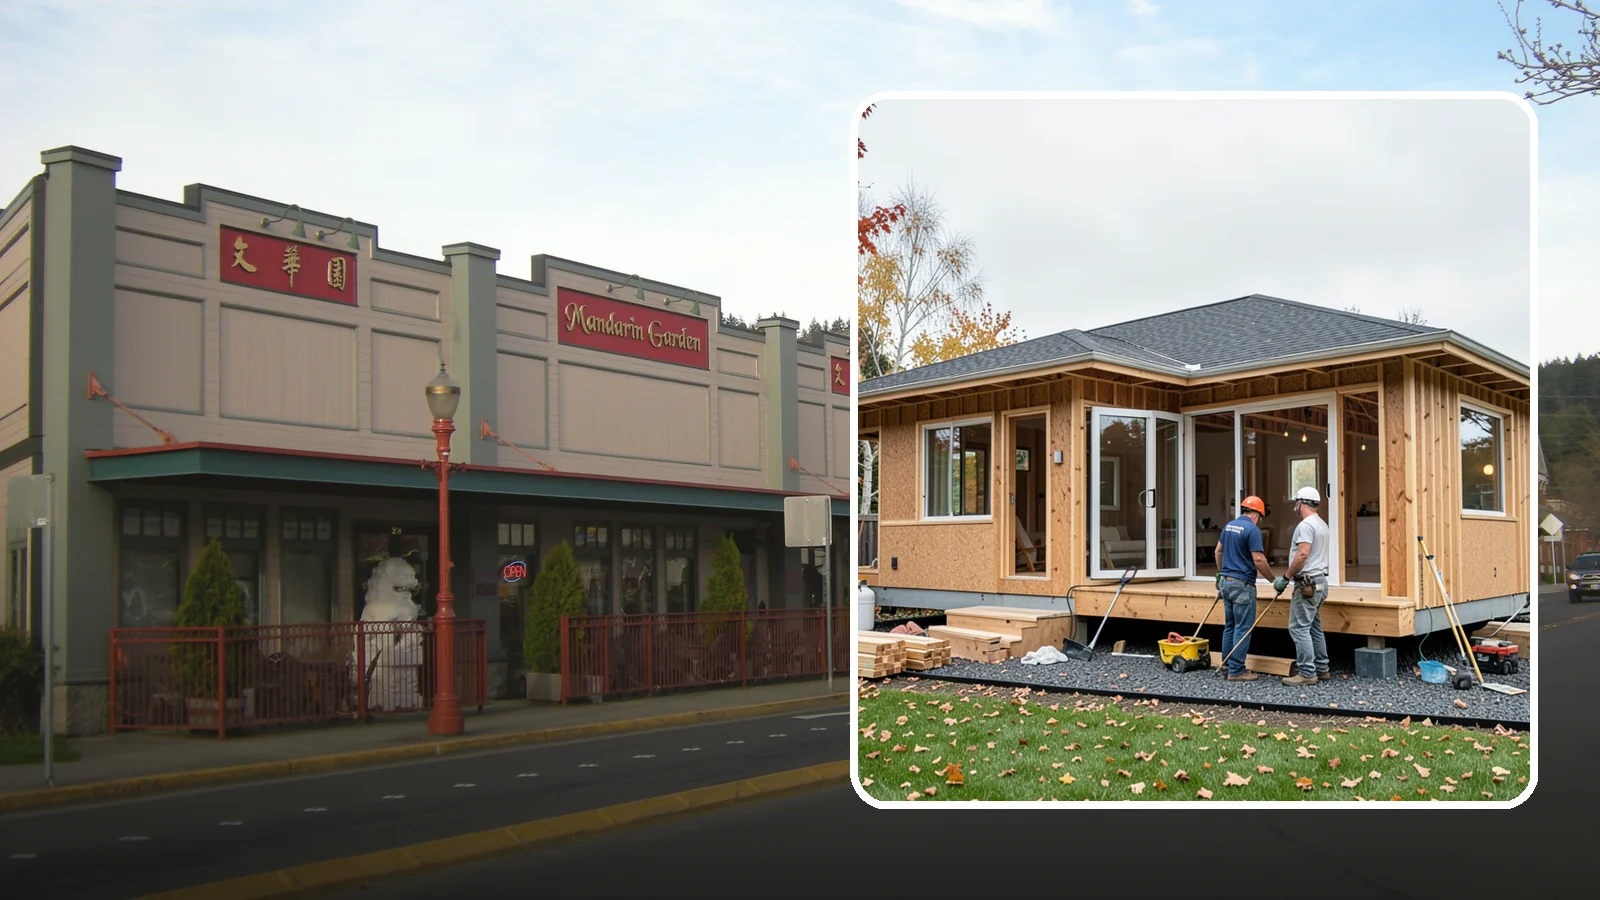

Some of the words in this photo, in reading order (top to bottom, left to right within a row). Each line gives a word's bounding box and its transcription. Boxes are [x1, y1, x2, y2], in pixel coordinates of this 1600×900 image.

[231, 236, 346, 291] 文華園
[564, 302, 644, 341] Mandarin
[647, 320, 702, 352] Garden
[503, 565, 527, 579] OPEN
